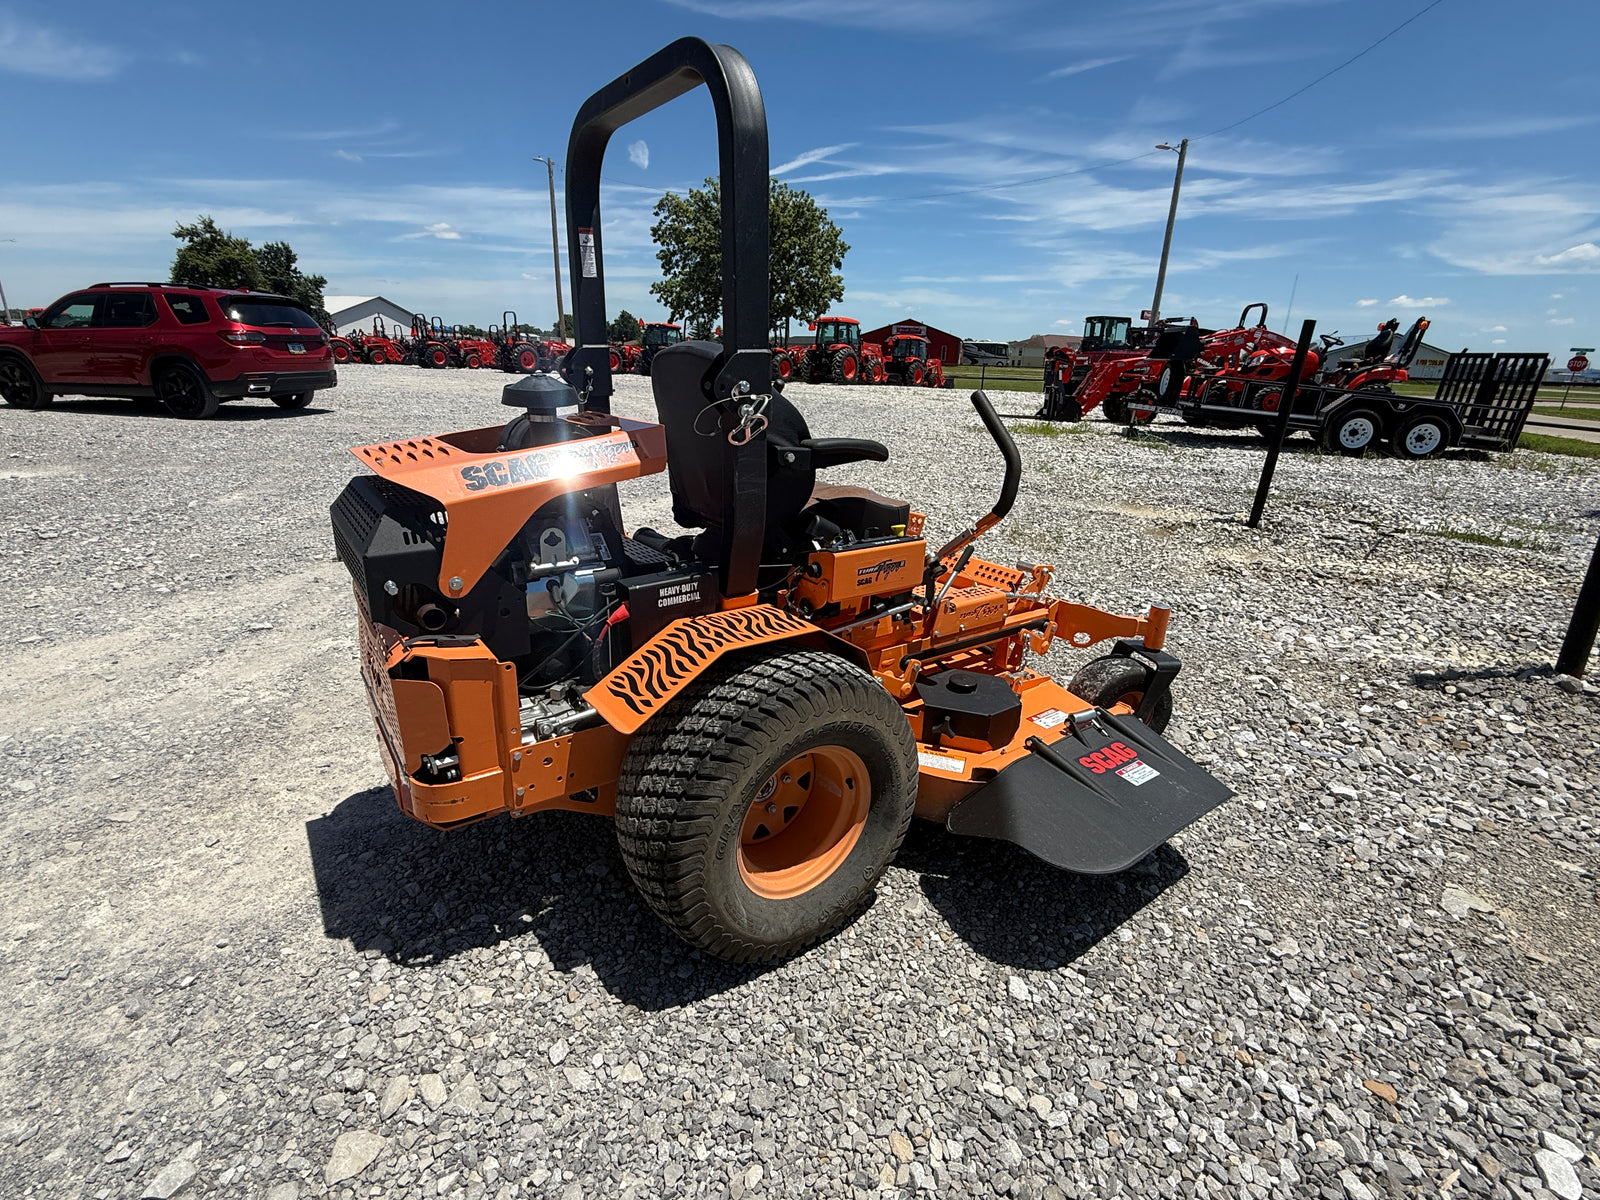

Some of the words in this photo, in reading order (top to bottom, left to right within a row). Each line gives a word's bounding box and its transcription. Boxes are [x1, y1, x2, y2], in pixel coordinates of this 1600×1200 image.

[1568, 360, 1587, 368] STOP
[857, 577, 872, 587] SCAG
[657, 591, 701, 608] COMMERCIAL
[1079, 742, 1138, 774] SCAG
